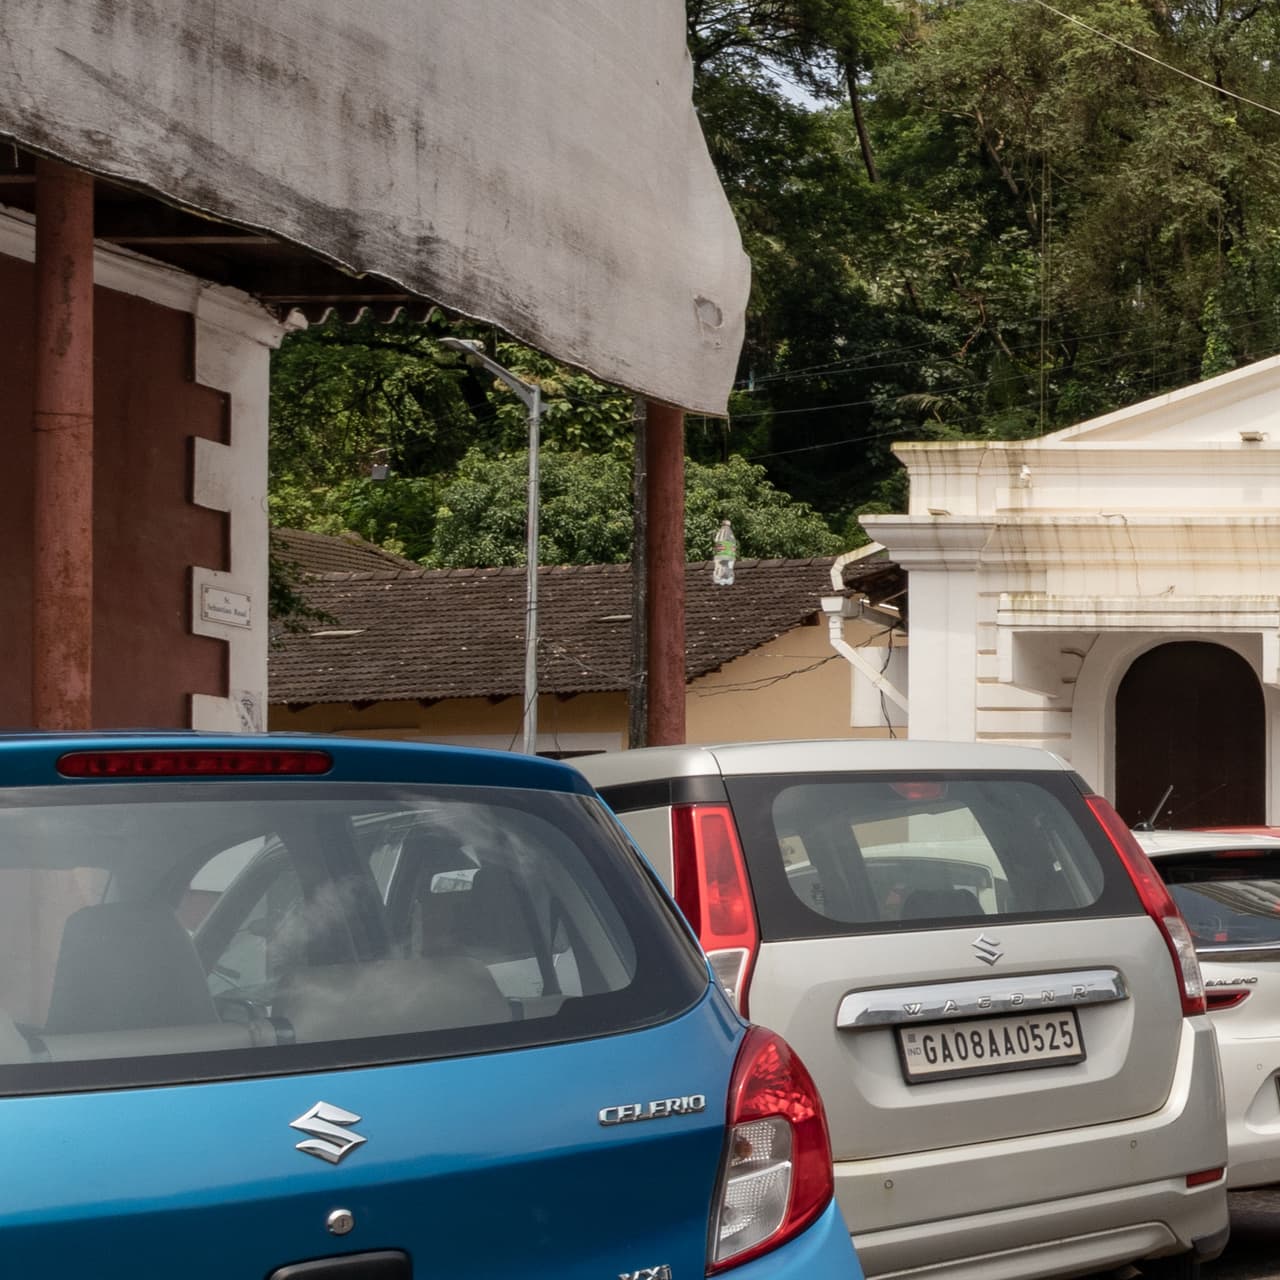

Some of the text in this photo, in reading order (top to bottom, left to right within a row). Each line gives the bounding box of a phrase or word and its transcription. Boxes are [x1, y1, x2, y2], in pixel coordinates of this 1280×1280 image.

[233, 608, 248, 618] Road
[1205, 977, 1258, 987] BALENO
[922, 1020, 1075, 1065] GA08AA0525
[907, 1046, 922, 1056] IND
[599, 1095, 706, 1125] CELERIO
